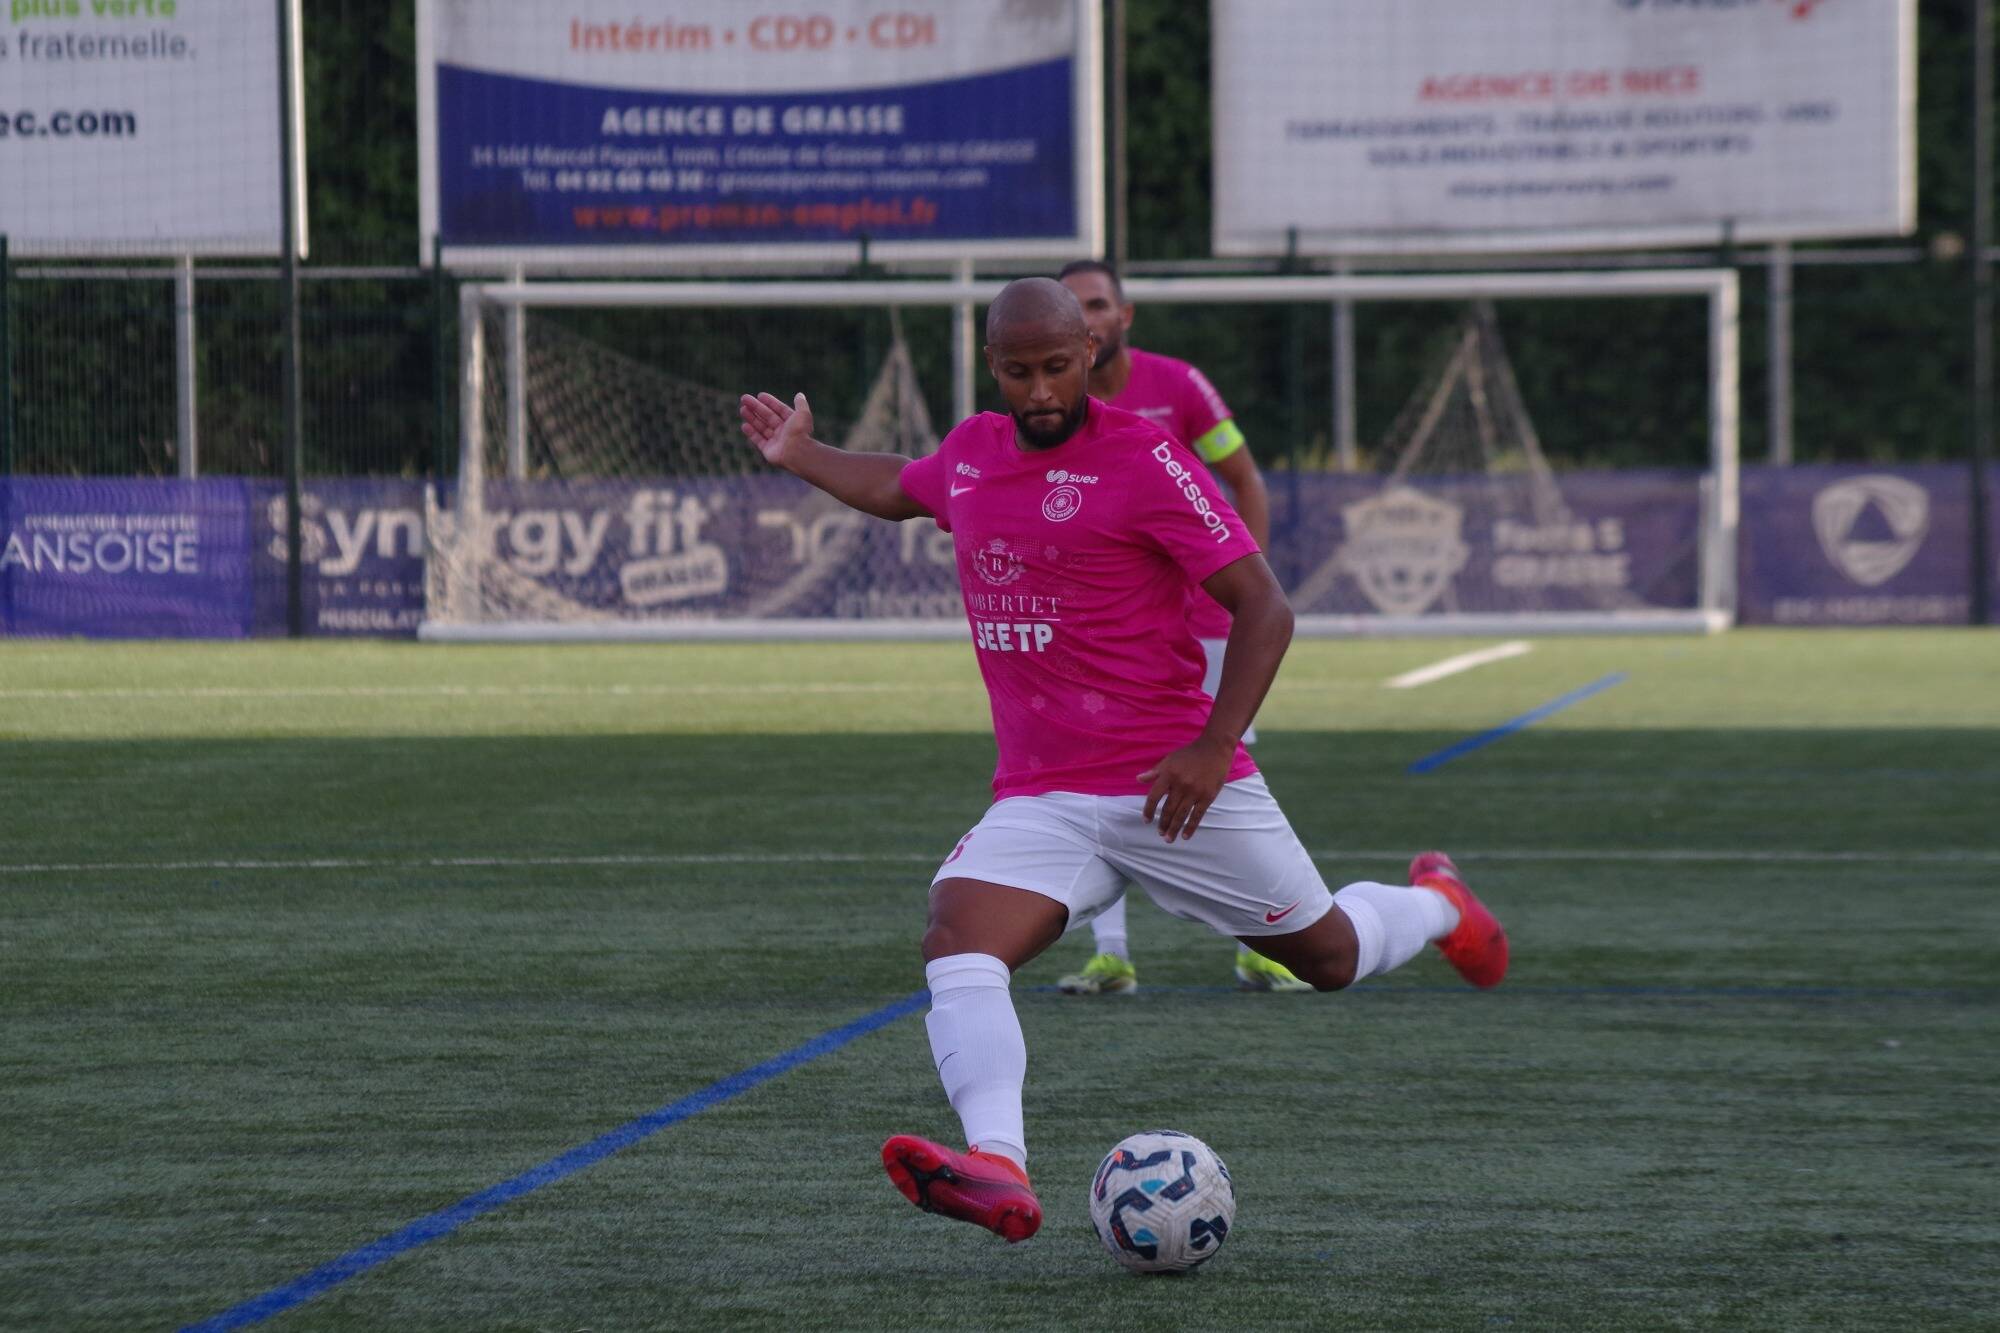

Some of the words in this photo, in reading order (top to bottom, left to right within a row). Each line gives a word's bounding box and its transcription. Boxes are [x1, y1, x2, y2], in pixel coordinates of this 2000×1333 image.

[570, 17, 713, 50] Intérim
[748, 15, 834, 49] CDD
[867, 14, 937, 47] CDI
[601, 106, 724, 136] AGENCE
[732, 106, 774, 135] DE
[782, 105, 905, 136] GRASSE
[1068, 474, 1099, 484] suez
[1152, 441, 1230, 543] betsson
[267, 491, 611, 577] Synrgy
[993, 557, 1002, 571] R
[977, 621, 1053, 652] SEETP
